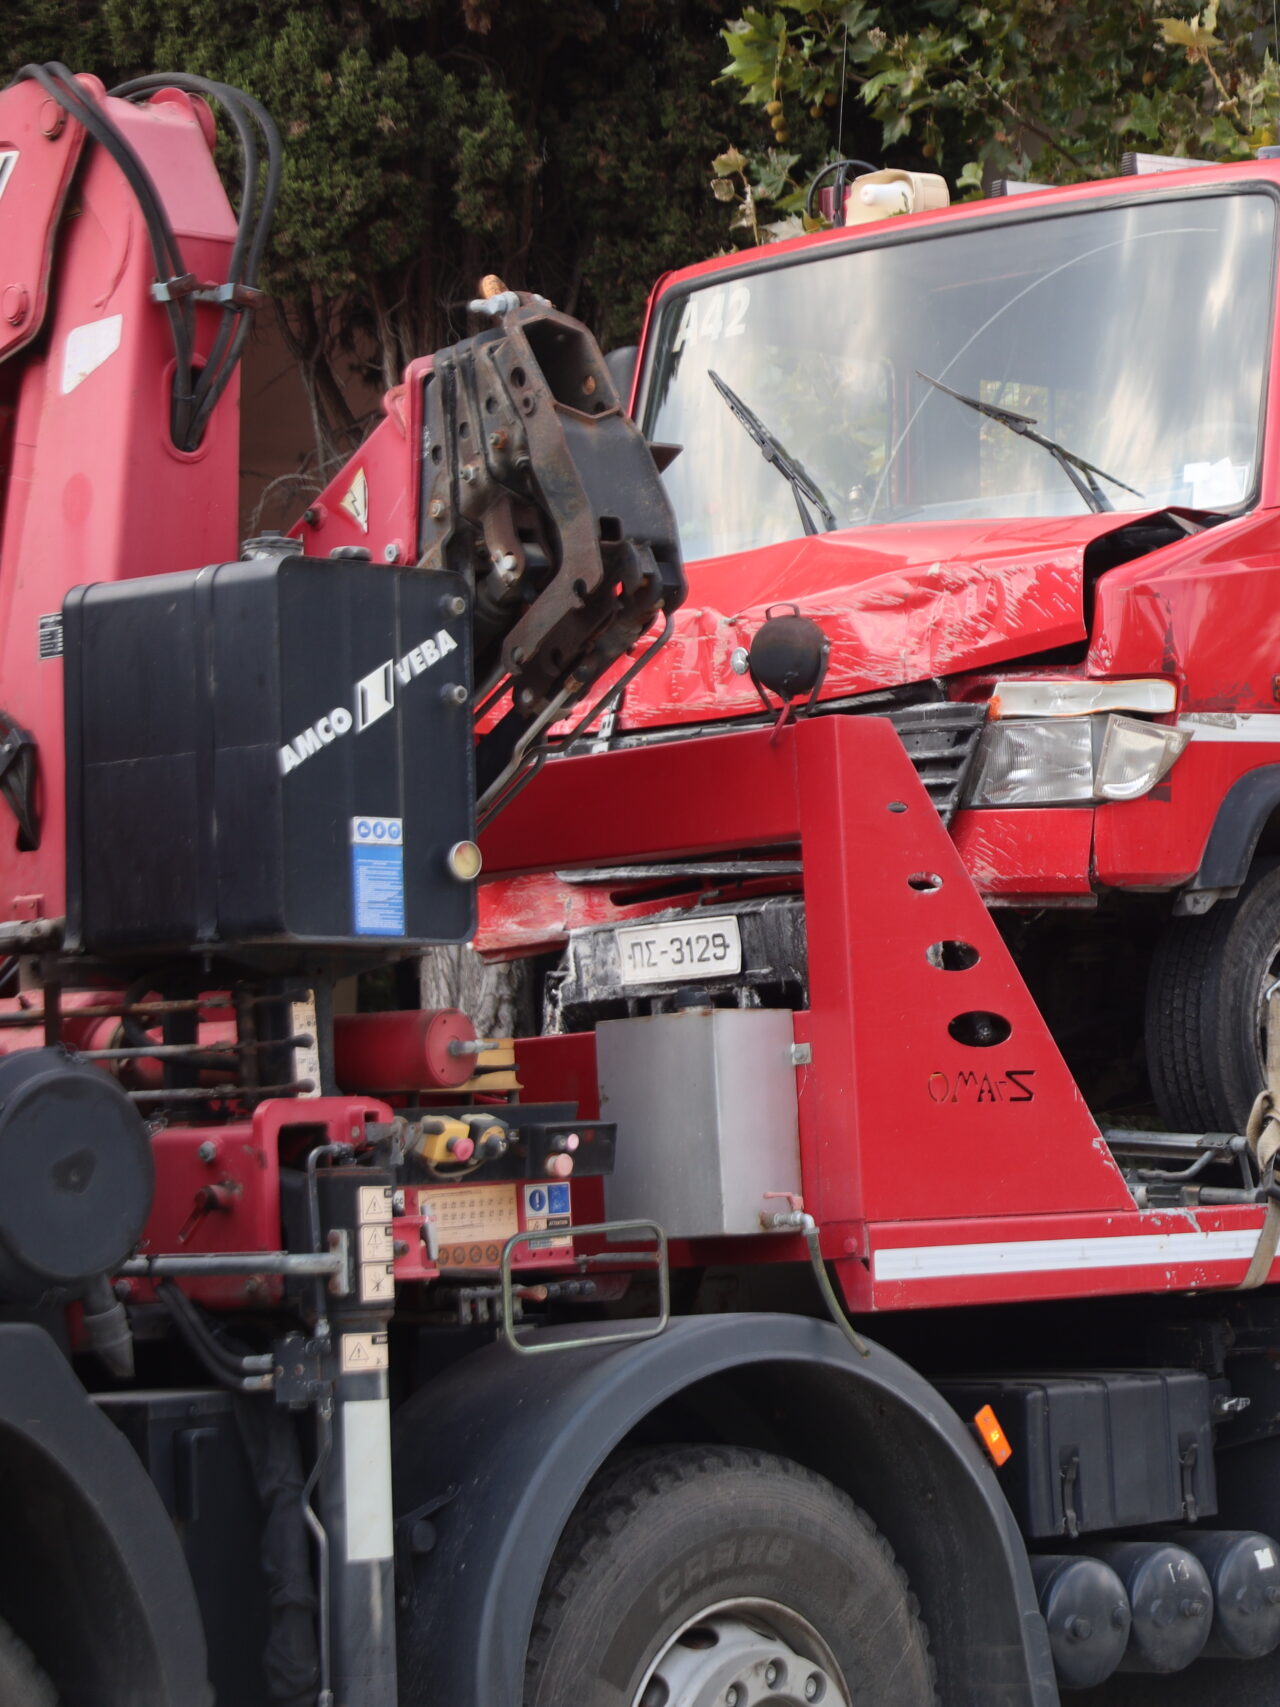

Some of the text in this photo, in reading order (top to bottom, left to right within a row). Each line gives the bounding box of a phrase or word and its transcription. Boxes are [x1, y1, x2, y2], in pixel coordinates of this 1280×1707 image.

[673, 287, 751, 353] A42
[278, 629, 458, 775] AMCO VEBA
[630, 932, 729, 969] ΠΣ-3129
